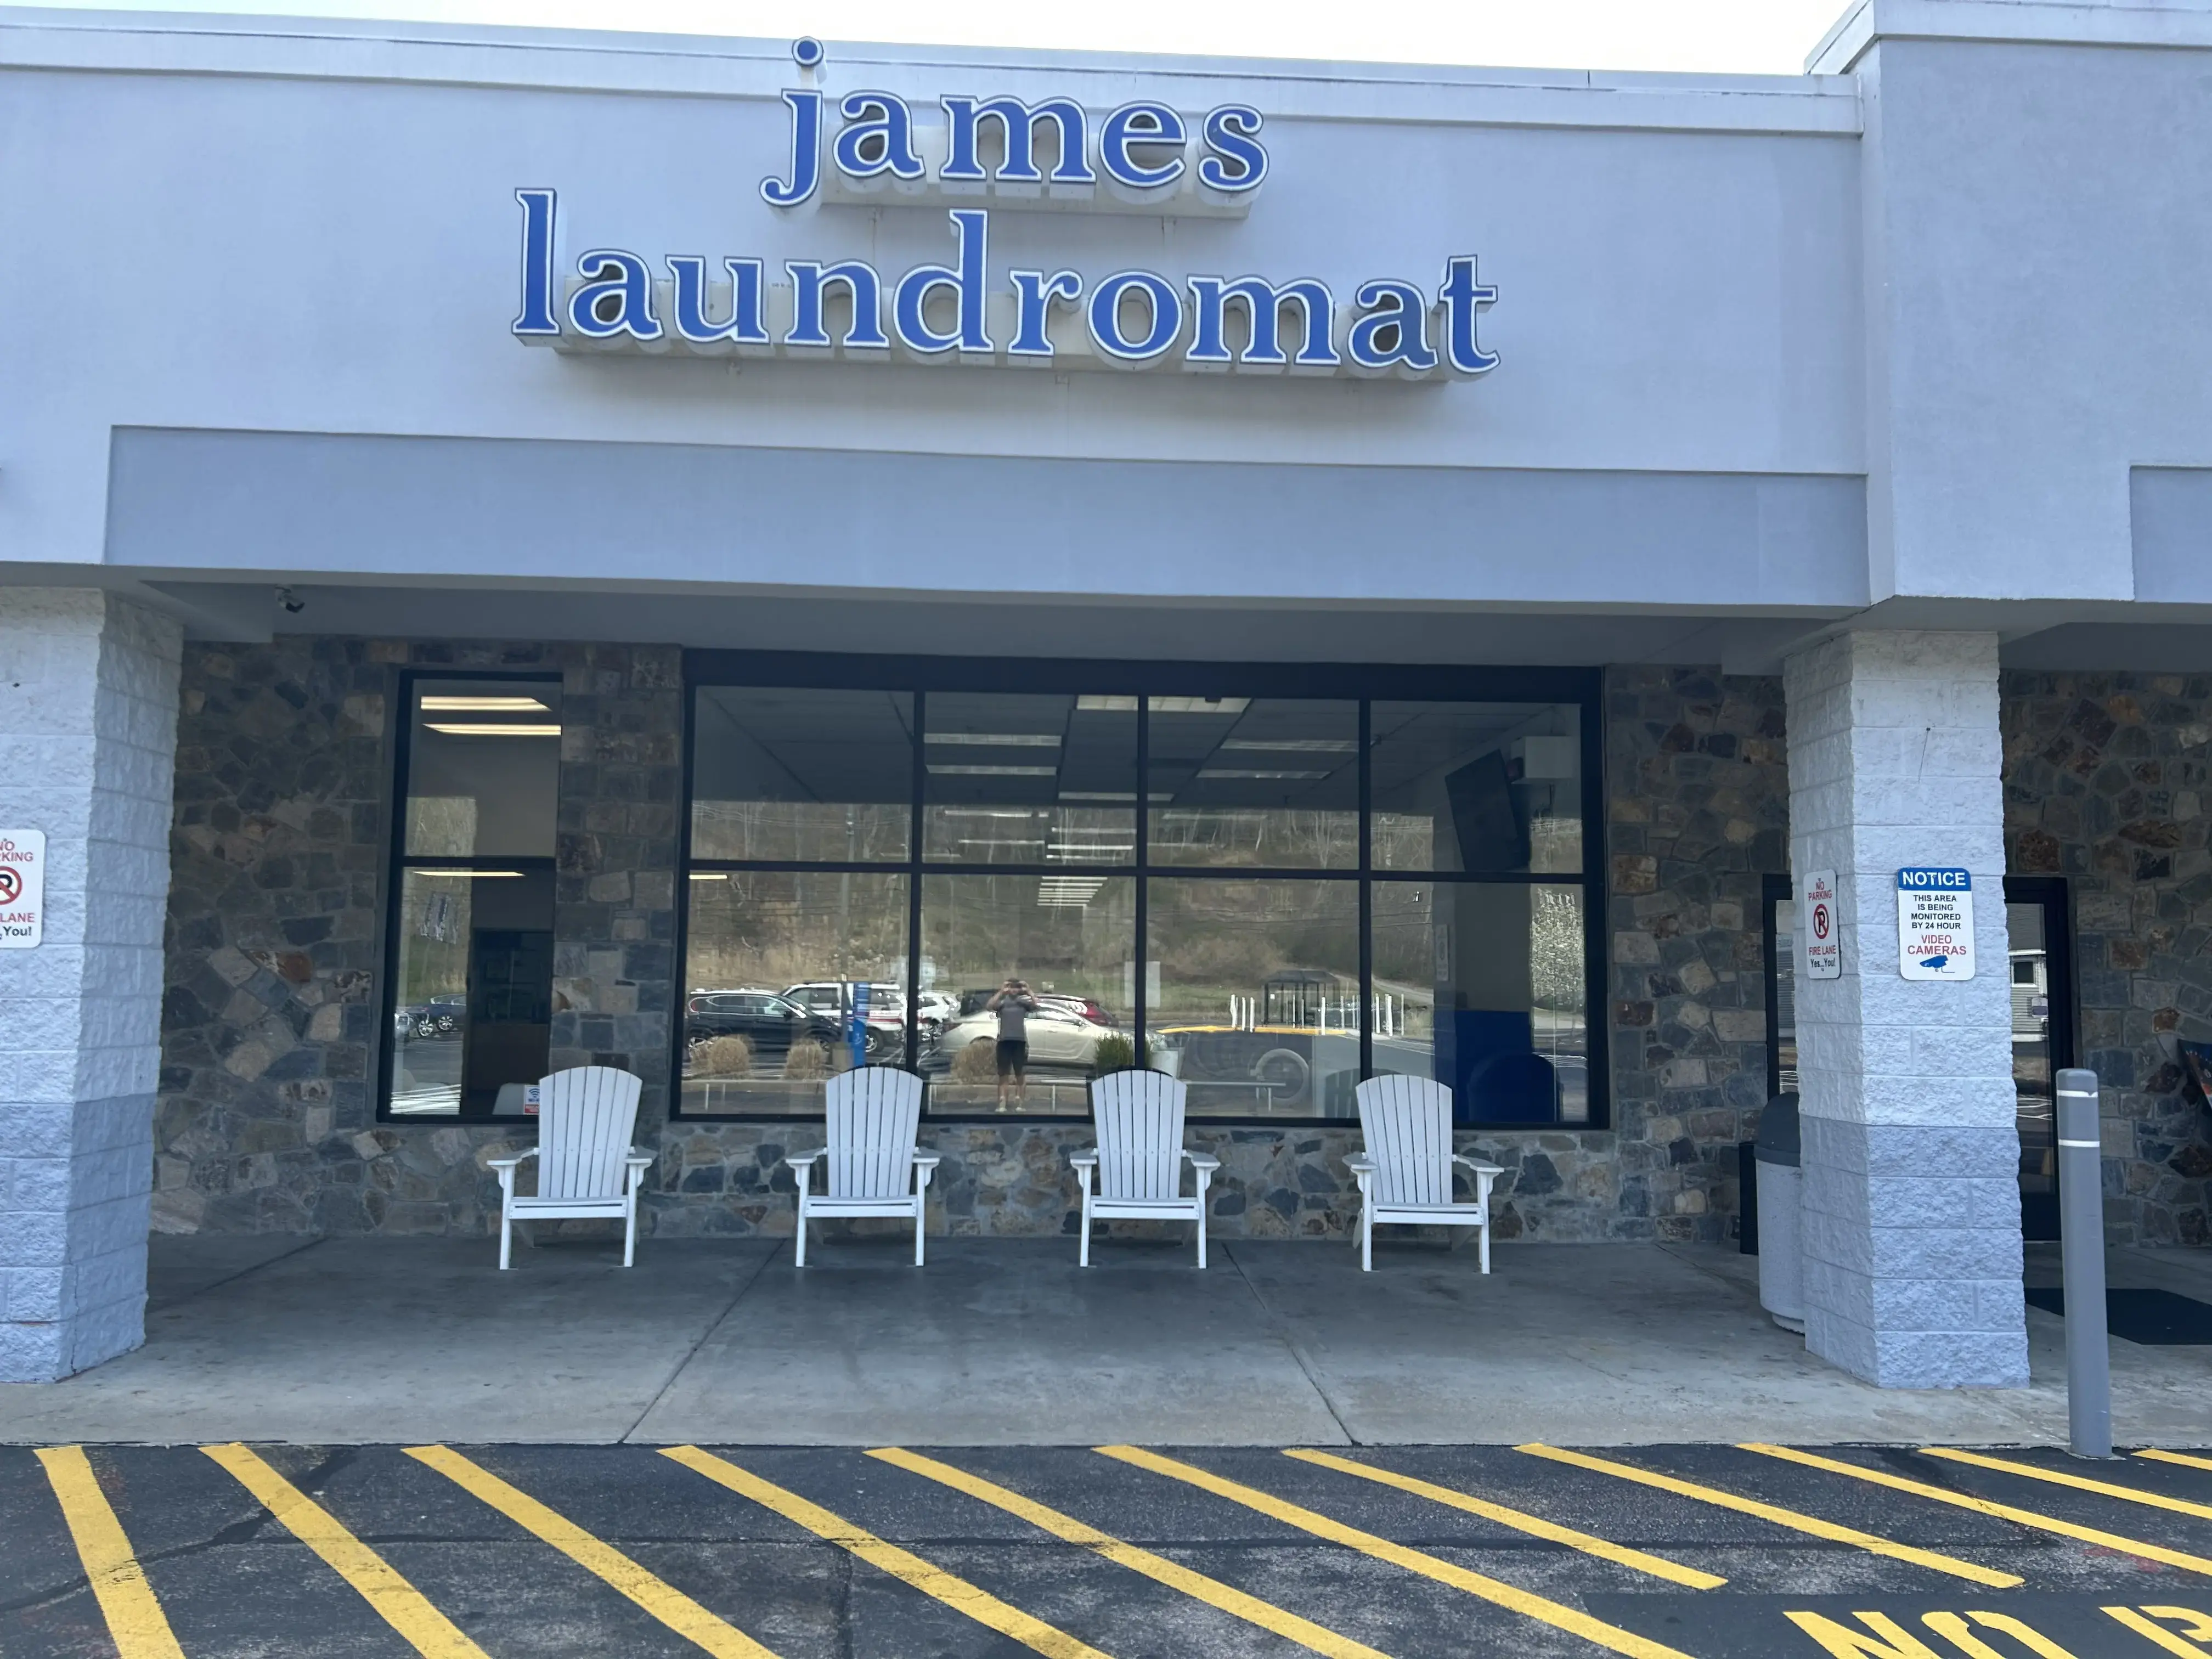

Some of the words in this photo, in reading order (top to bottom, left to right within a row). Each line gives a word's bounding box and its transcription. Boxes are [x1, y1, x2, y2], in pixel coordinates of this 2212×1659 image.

[759, 36, 1269, 207] james
[511, 188, 1502, 374] laundromat
[0, 851, 33, 862] KING
[1902, 871, 1966, 886] NOTICE
[1815, 881, 1825, 891] NO
[1808, 889, 1832, 901] PARKING
[1921, 934, 1952, 944] VIDEO
[1809, 946, 1821, 956] FIRE
[1821, 945, 1836, 955] LANE
[1907, 945, 1967, 956] CAMERAS
